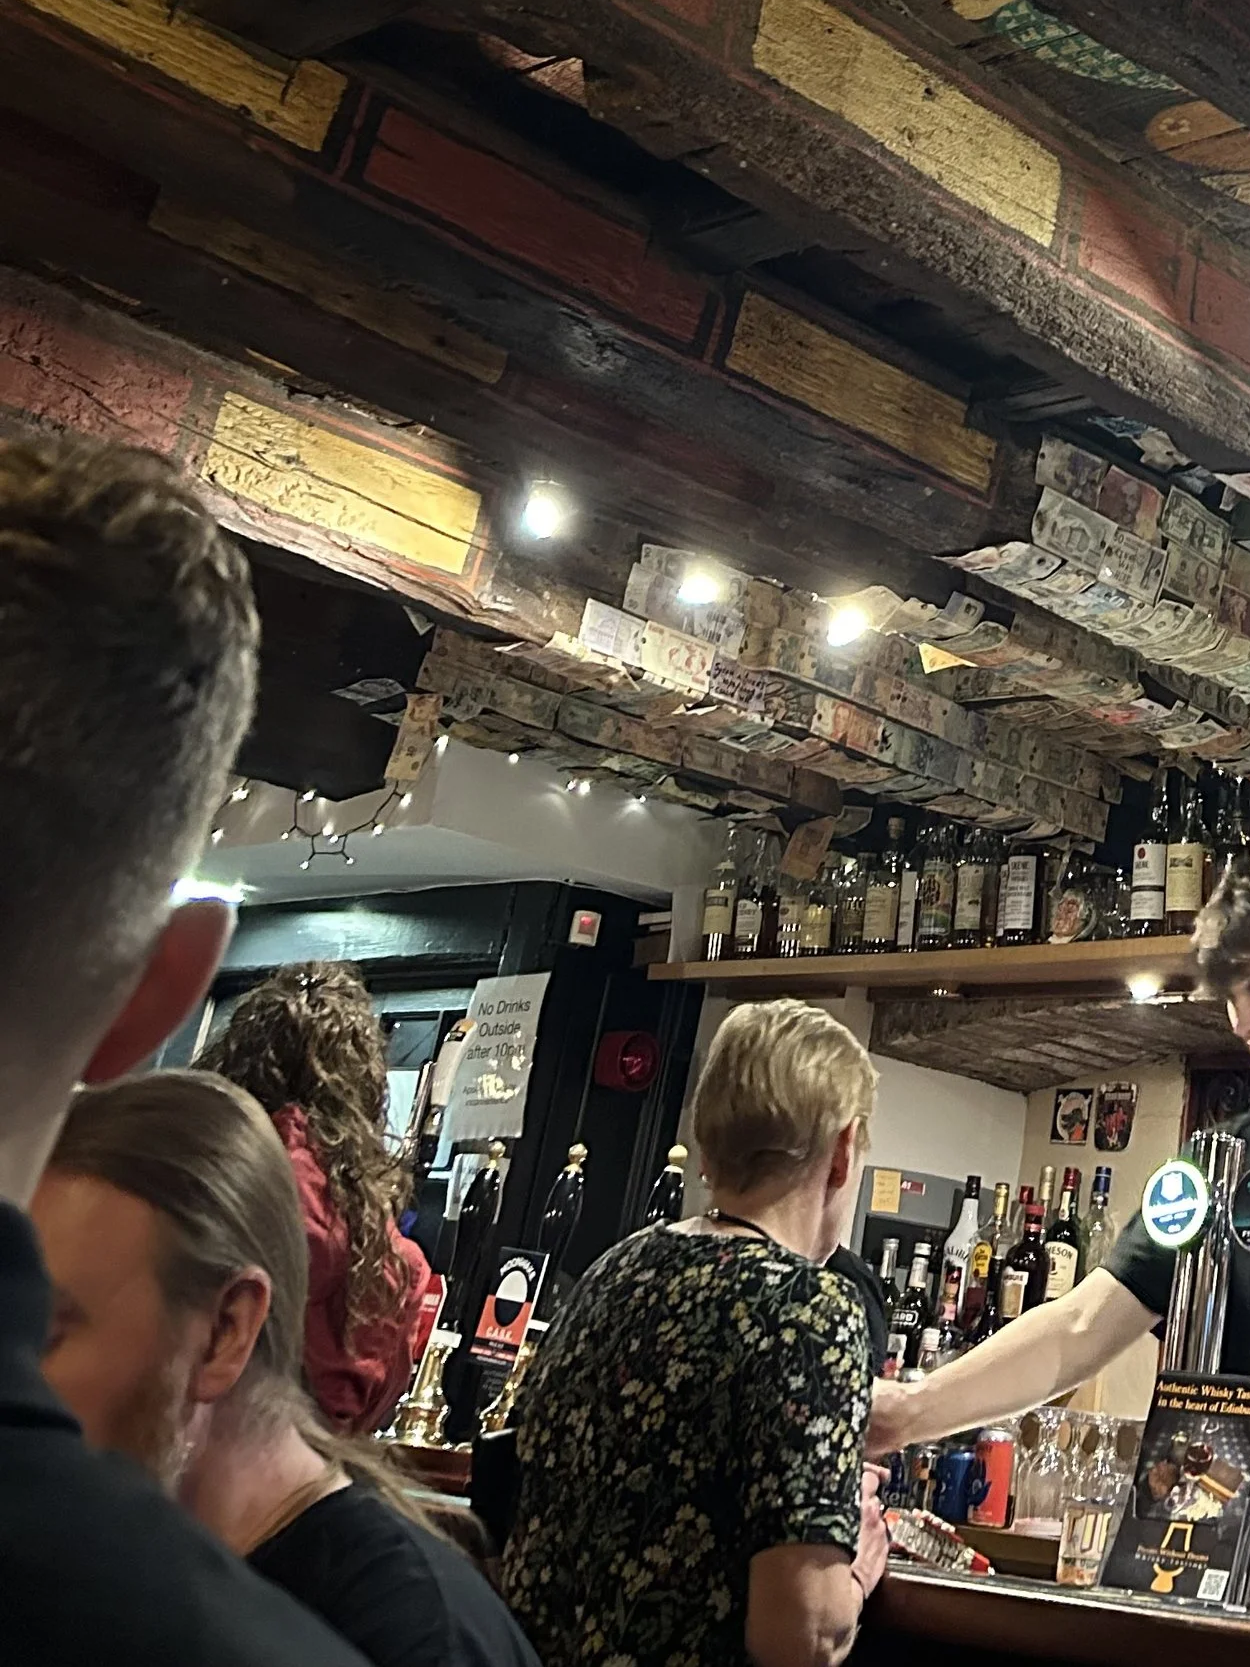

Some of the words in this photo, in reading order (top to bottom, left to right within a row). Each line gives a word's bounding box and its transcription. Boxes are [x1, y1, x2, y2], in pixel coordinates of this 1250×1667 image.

[479, 1003, 493, 1016] No
[496, 999, 531, 1015] Drinks
[479, 1021, 521, 1037] Outside
[467, 1045, 492, 1060] after
[1046, 1247, 1072, 1259] MESON
[1157, 1381, 1198, 1395] Authentic
[1202, 1385, 1233, 1400] Whisky
[1157, 1396, 1167, 1407] in
[1169, 1397, 1182, 1409] the
[1185, 1399, 1207, 1412] heart
[1209, 1401, 1219, 1412] of
